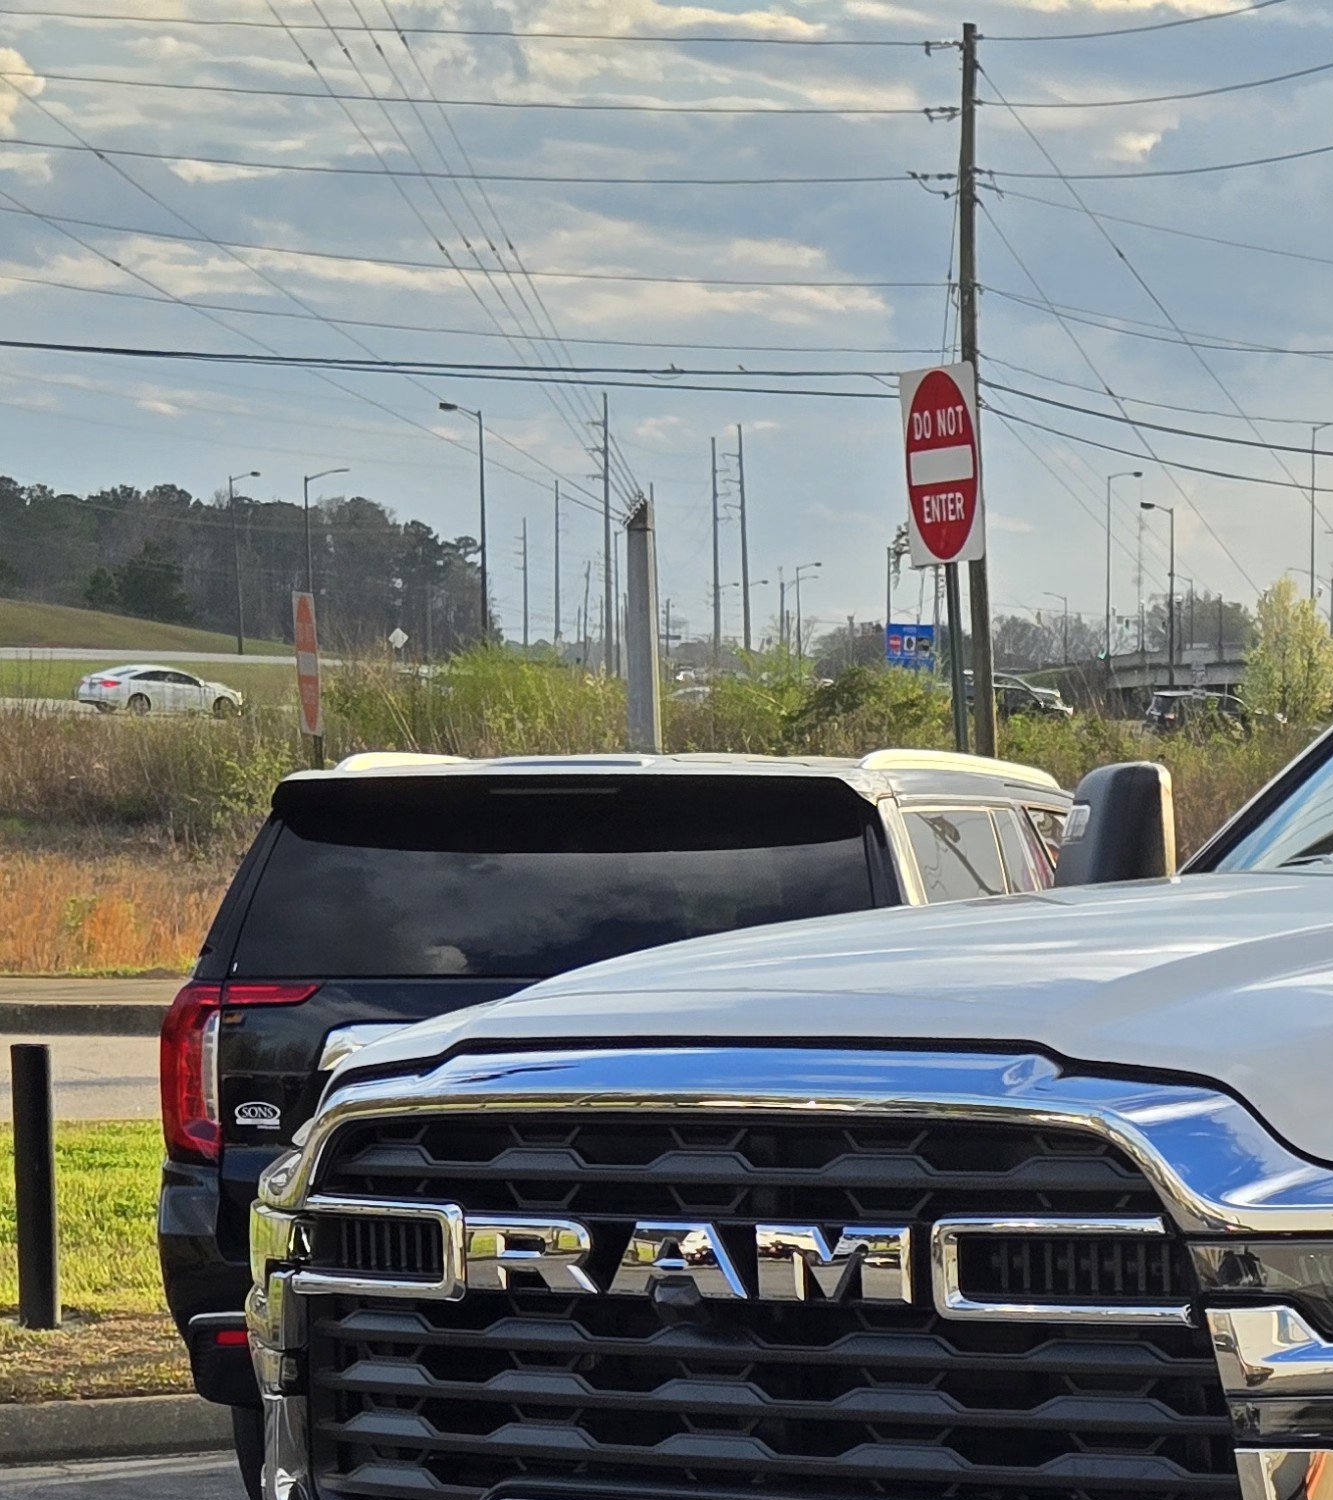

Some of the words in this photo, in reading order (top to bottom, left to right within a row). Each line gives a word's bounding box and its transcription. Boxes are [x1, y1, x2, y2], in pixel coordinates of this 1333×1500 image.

[913, 410, 932, 440] DO
[936, 405, 964, 437] NOT
[922, 492, 965, 524] ENTER
[242, 1106, 274, 1118] SONS
[465, 1215, 912, 1305] RAM
